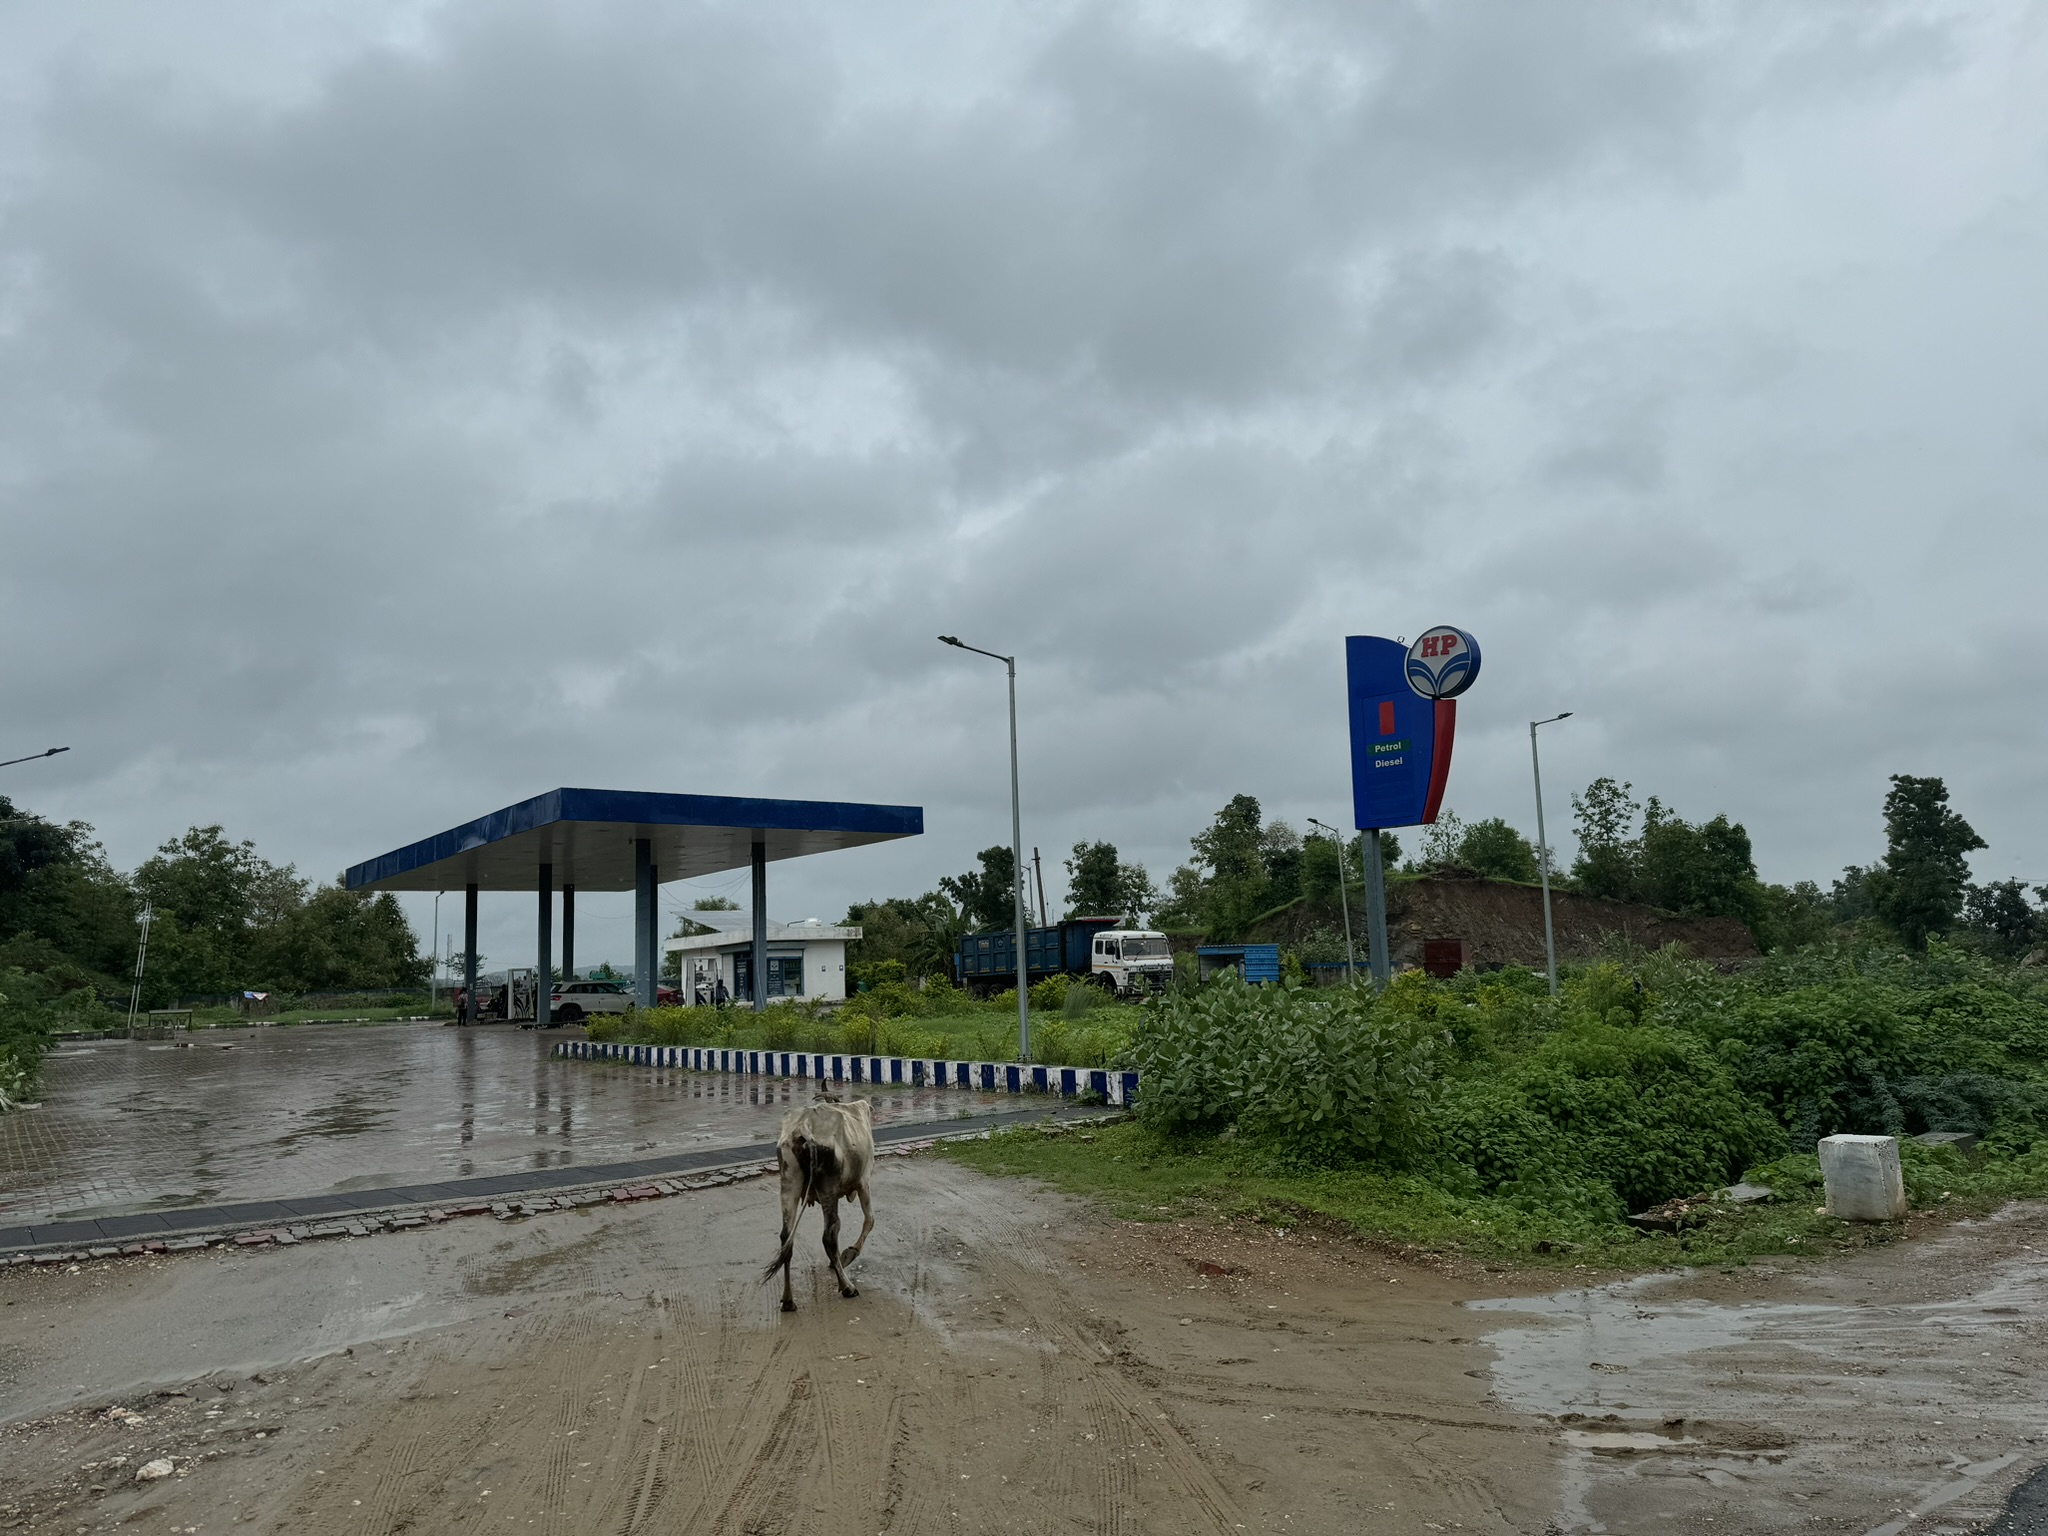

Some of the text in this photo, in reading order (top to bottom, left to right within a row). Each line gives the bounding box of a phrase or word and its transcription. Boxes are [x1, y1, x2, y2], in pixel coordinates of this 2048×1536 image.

[1421, 634, 1457, 658] HP
[1374, 741, 1402, 753] Petrol
[1375, 756, 1403, 768] Diesel
